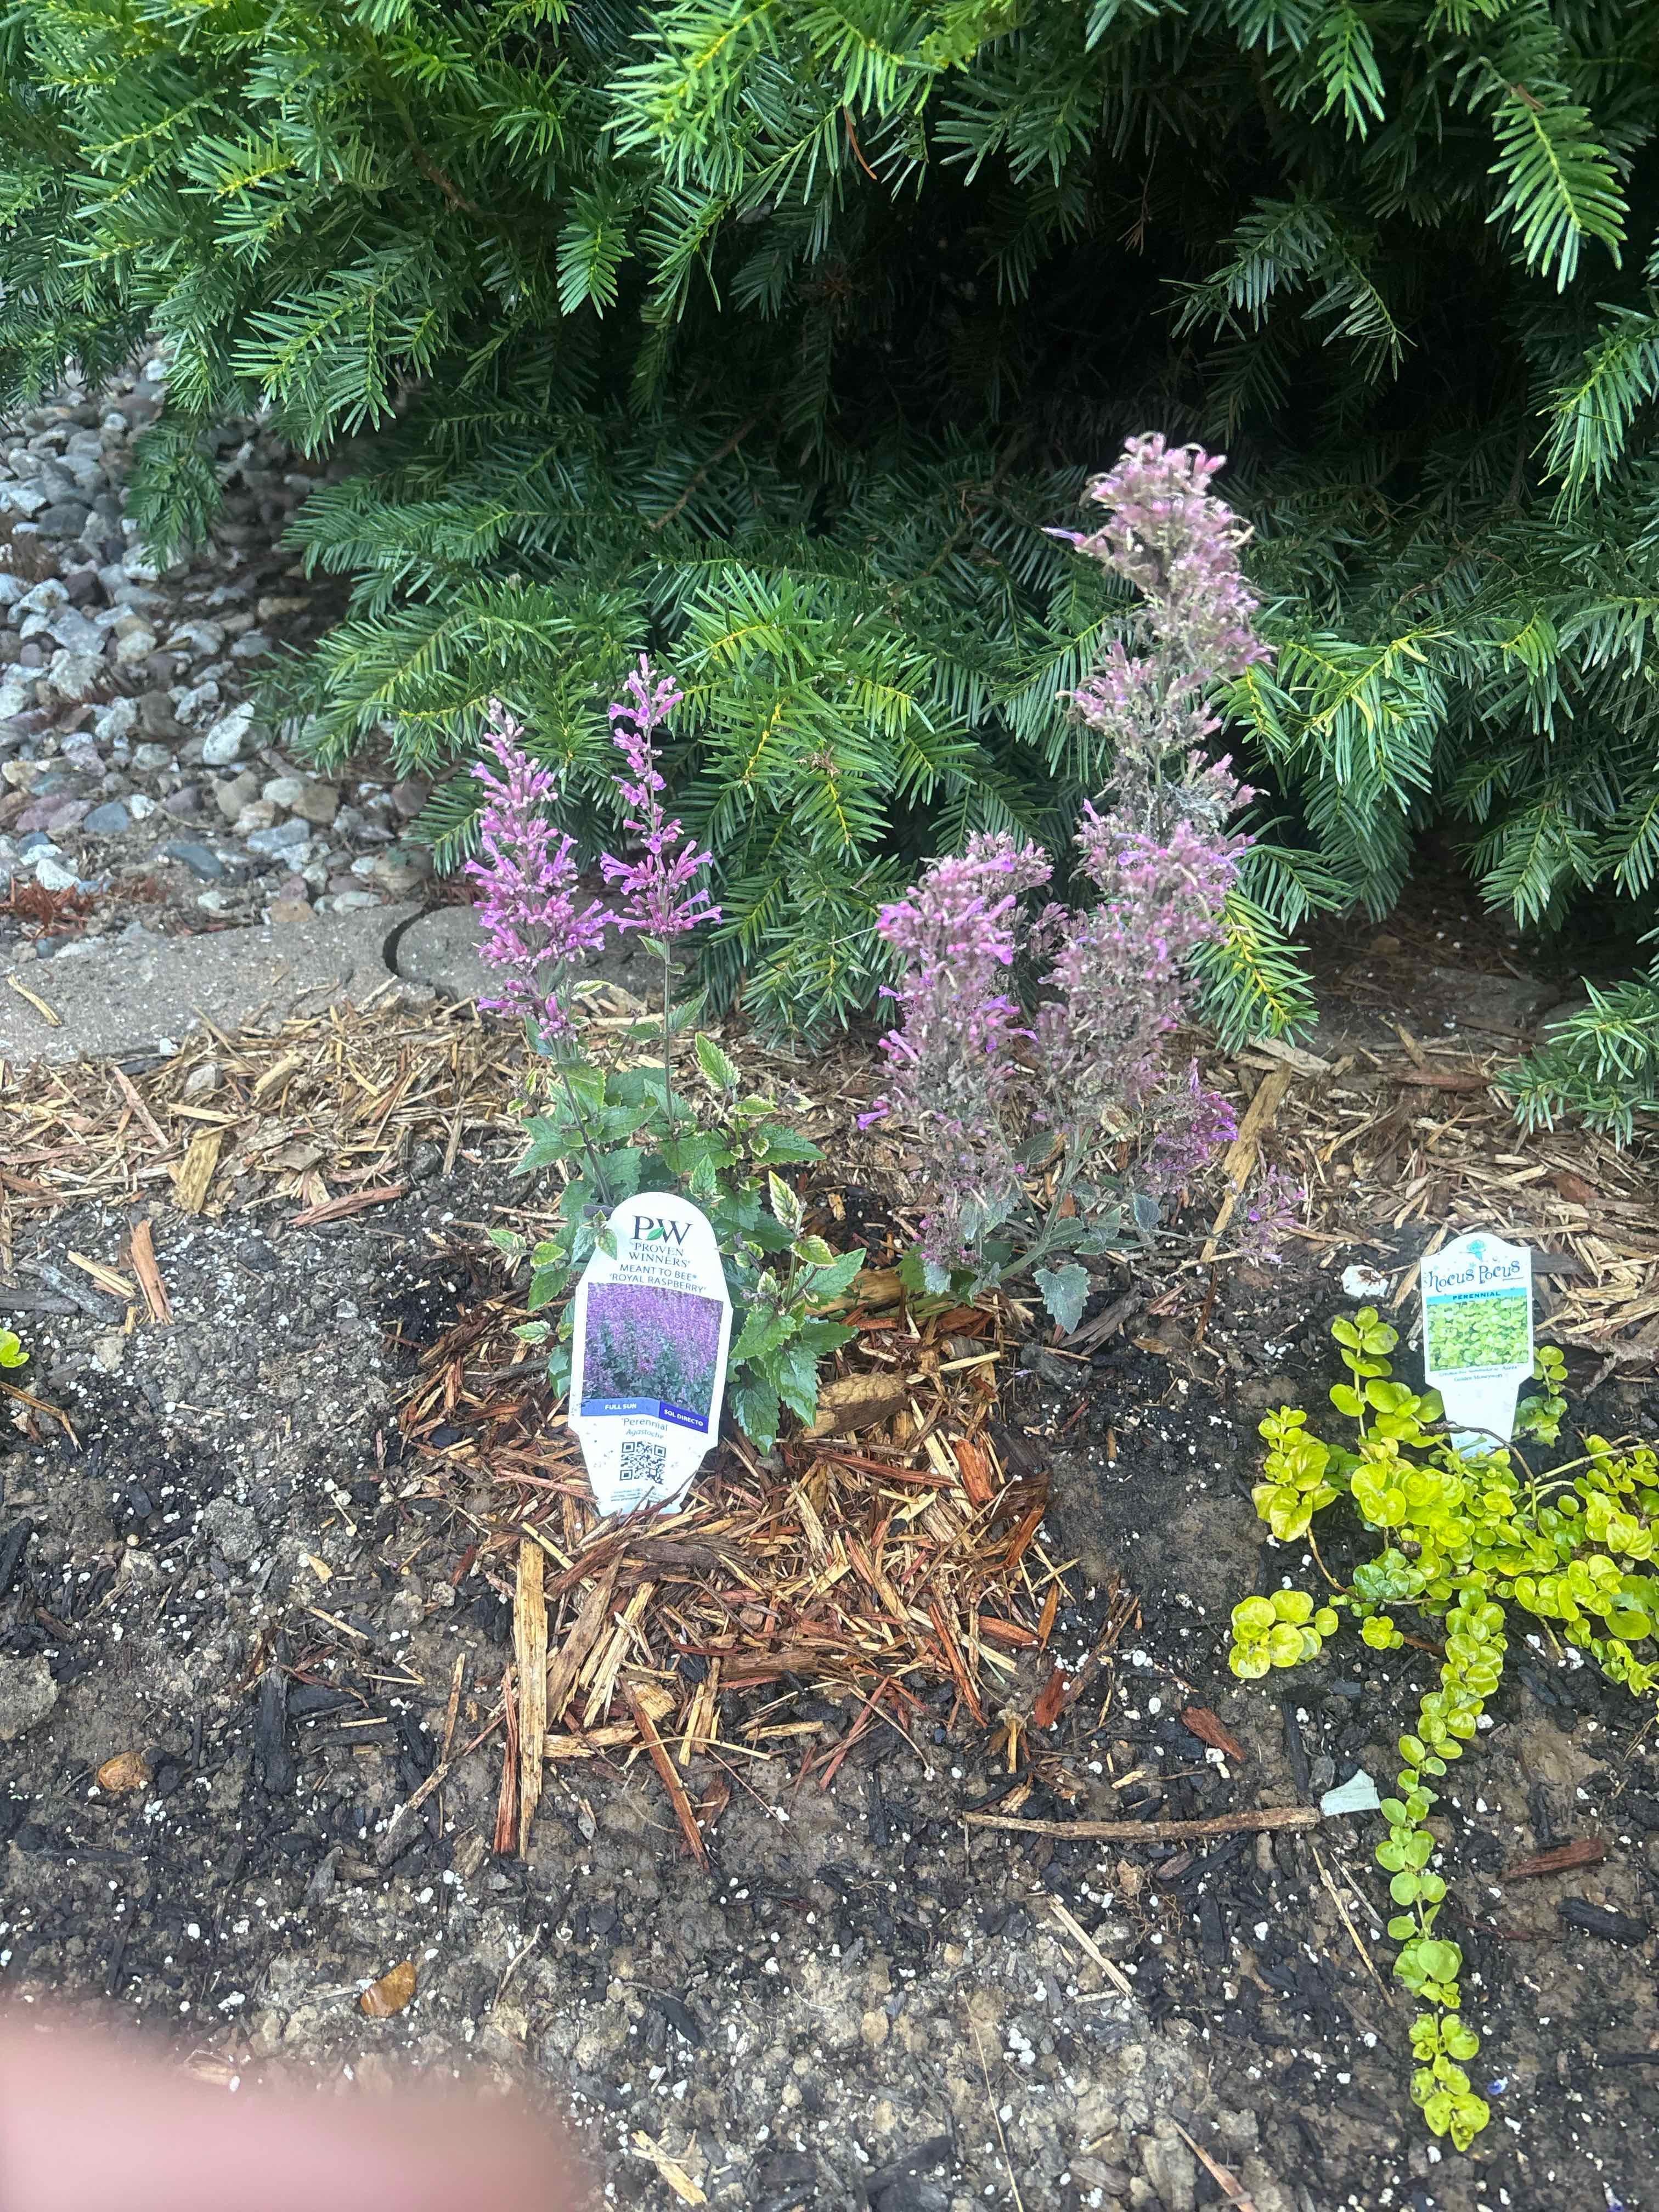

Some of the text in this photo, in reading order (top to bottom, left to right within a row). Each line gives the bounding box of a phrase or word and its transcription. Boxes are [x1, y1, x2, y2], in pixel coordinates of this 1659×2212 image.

[634, 1242, 684, 1257] PROVEN
[619, 1263, 656, 1274] MEANT
[658, 1268, 672, 1277] TO
[1452, 1290, 1502, 1300] PERENNIAL
[623, 1417, 668, 1431] Perennial
[664, 1409, 704, 1426] SOL DIRECTO
